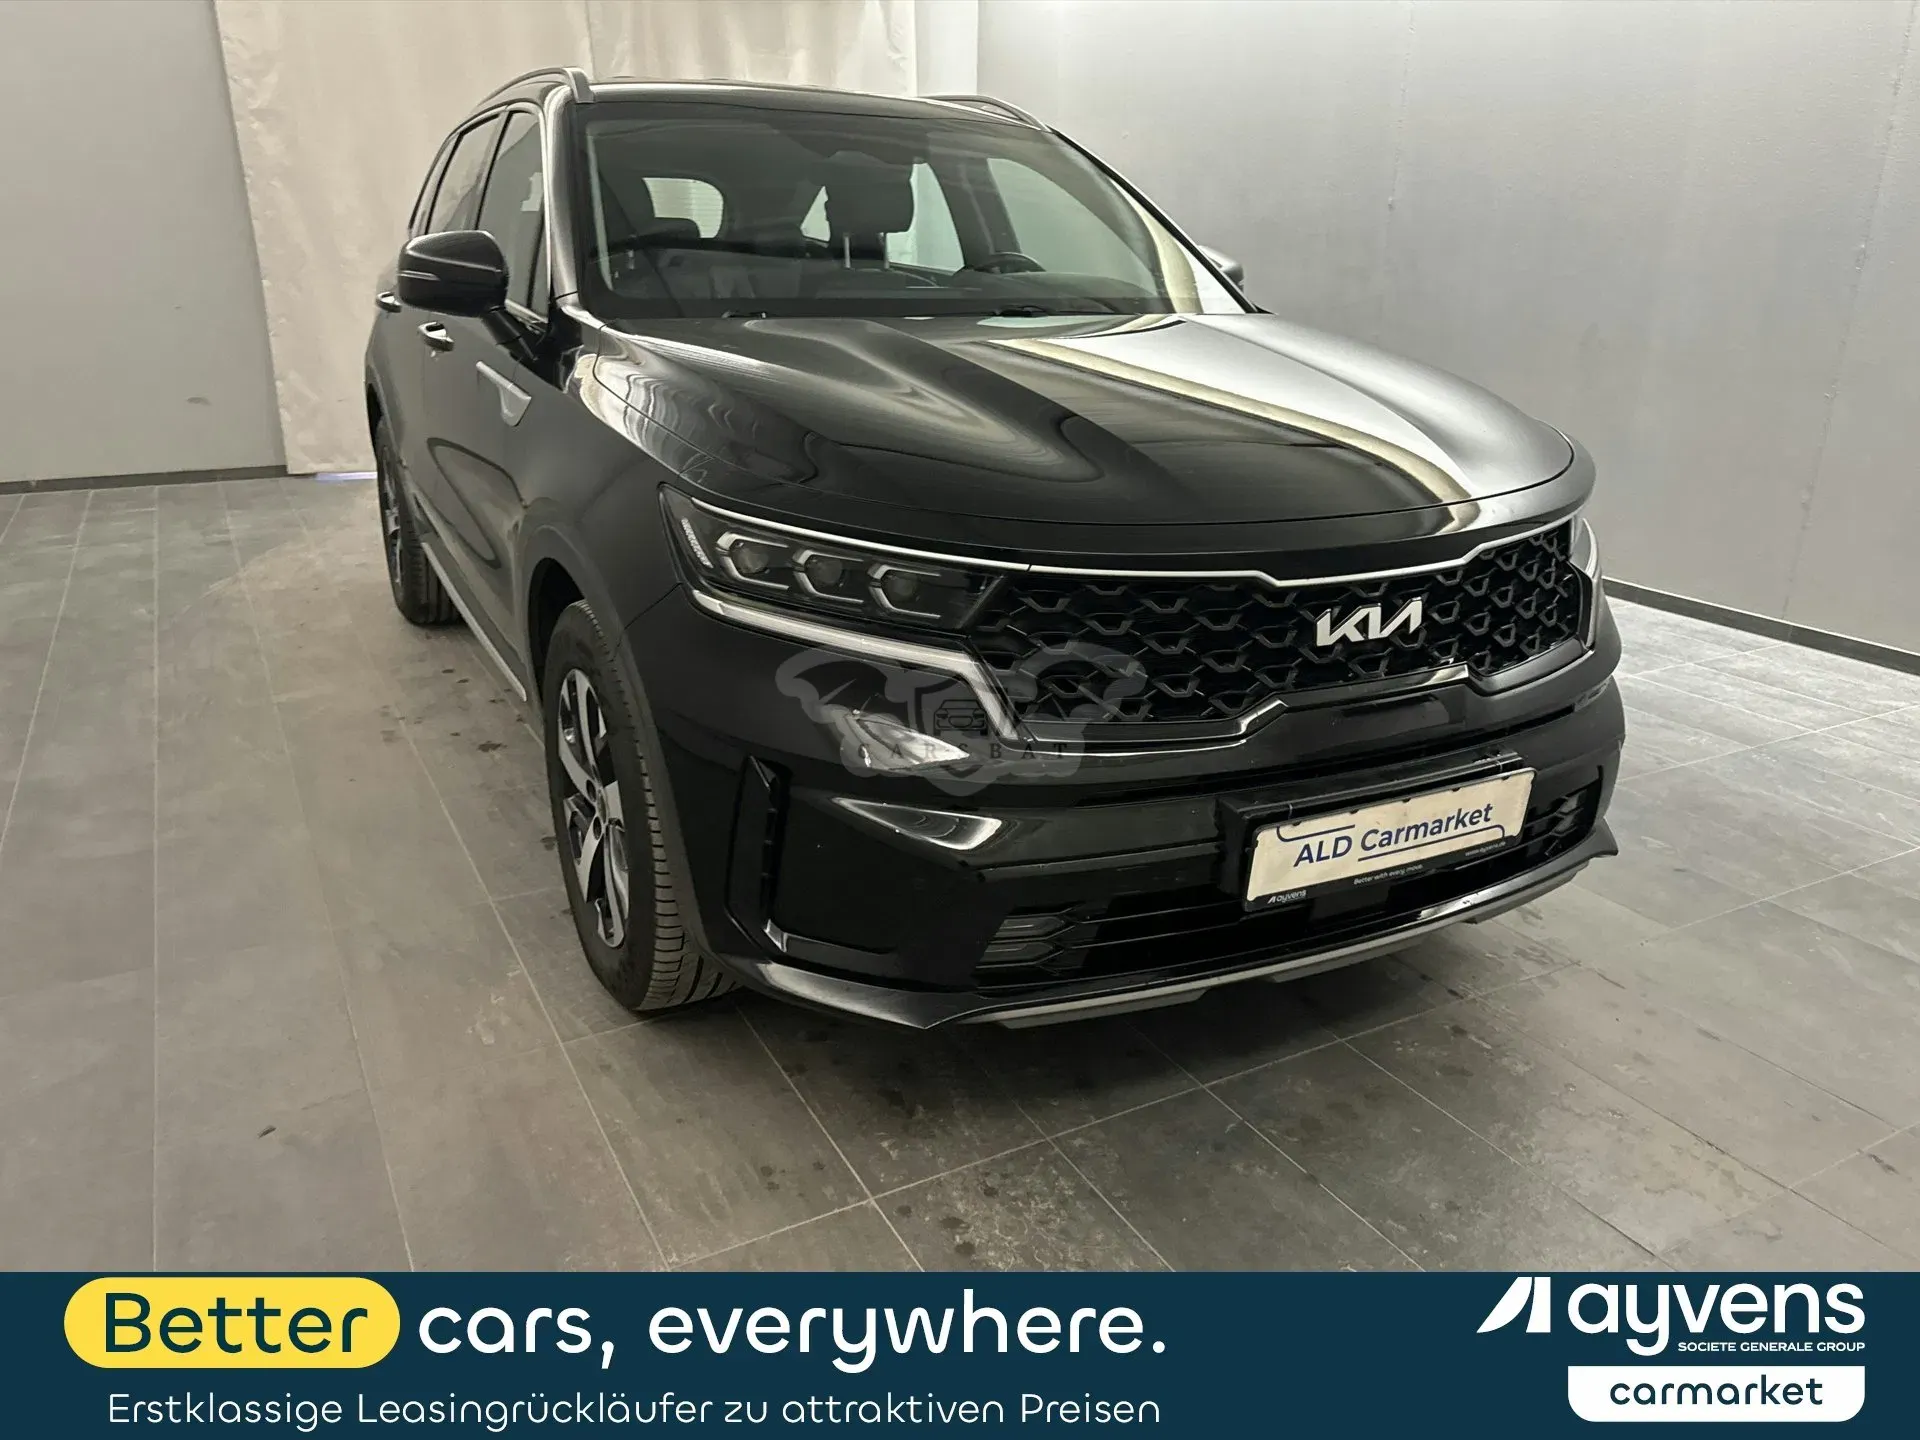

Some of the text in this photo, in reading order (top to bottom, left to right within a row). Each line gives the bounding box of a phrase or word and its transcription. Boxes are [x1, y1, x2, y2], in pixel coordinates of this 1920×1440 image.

[1316, 597, 1422, 646] KIA
[1293, 803, 1493, 867] ALD Carmarket
[1276, 889, 1307, 903] ayvens
